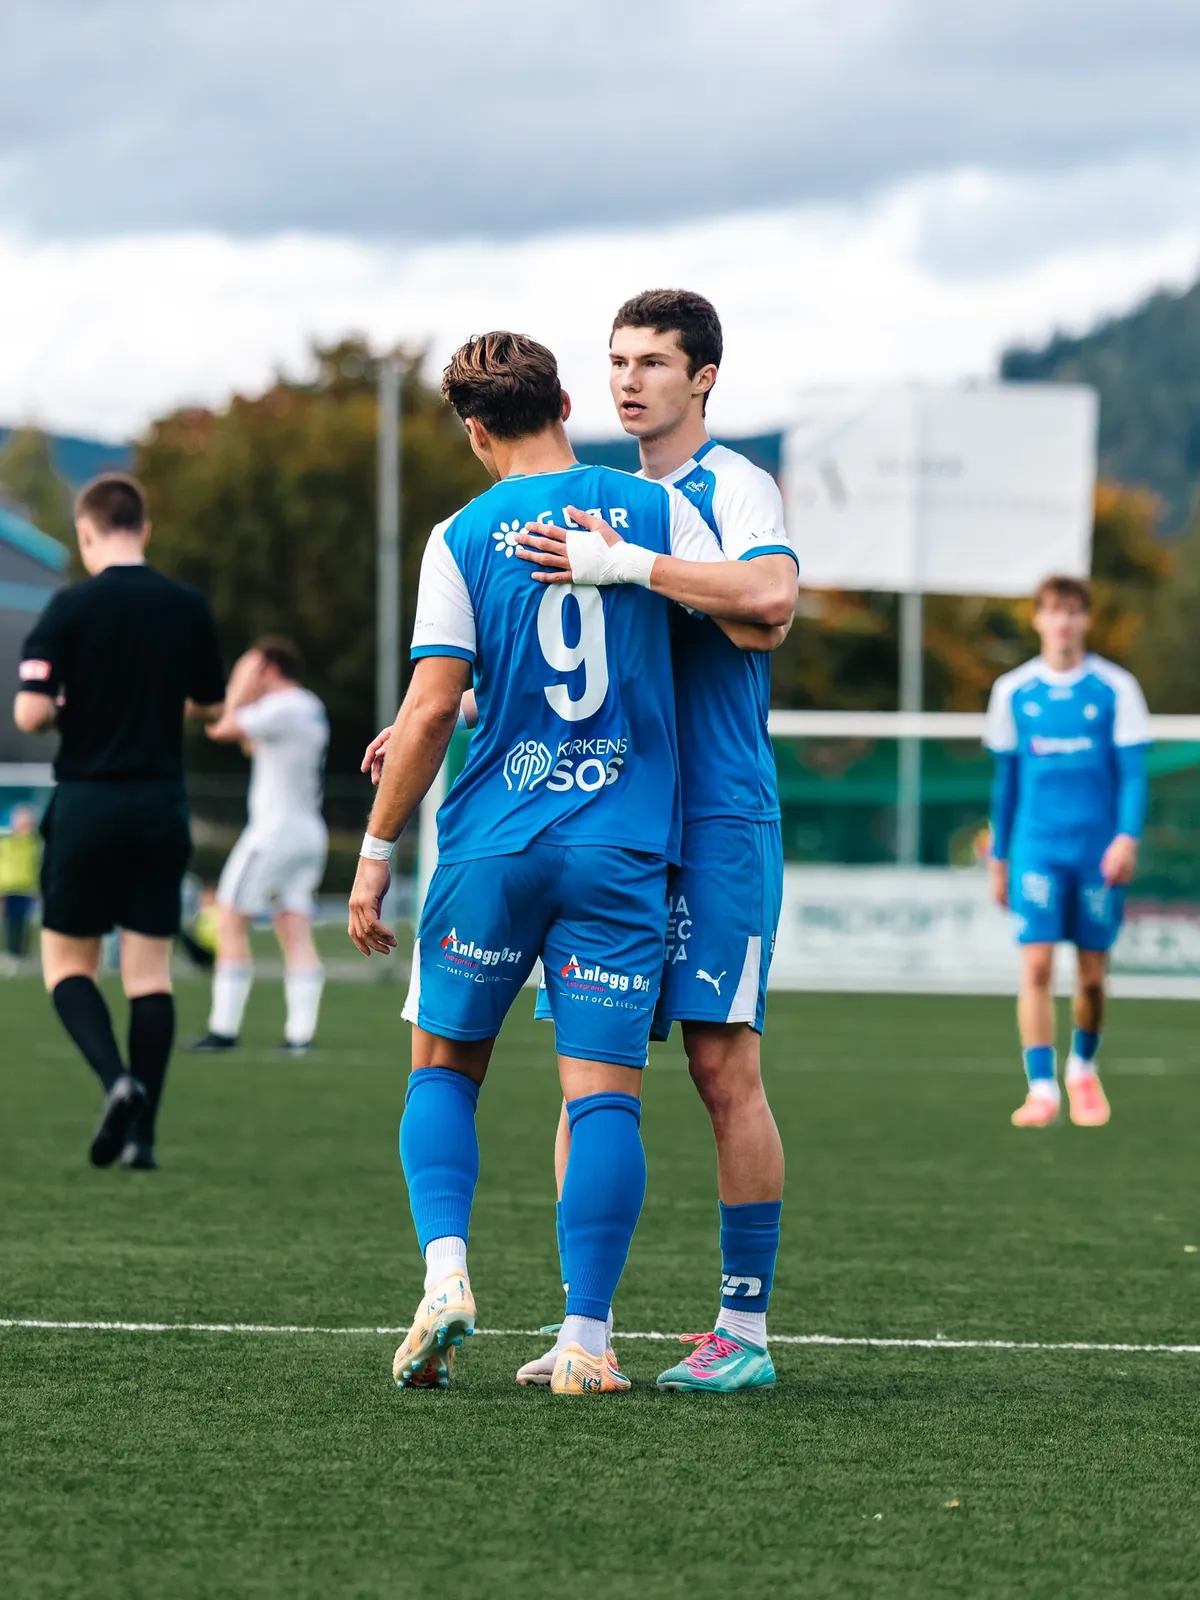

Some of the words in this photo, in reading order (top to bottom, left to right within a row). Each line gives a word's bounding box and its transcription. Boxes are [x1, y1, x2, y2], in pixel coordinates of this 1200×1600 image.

[537, 583, 609, 722] 9
[556, 738, 628, 758] KIRKENS
[546, 758, 625, 792] SOS
[561, 954, 630, 991] Anlegg
[632, 973, 650, 993] Øst
[571, 993, 589, 1003] PART
